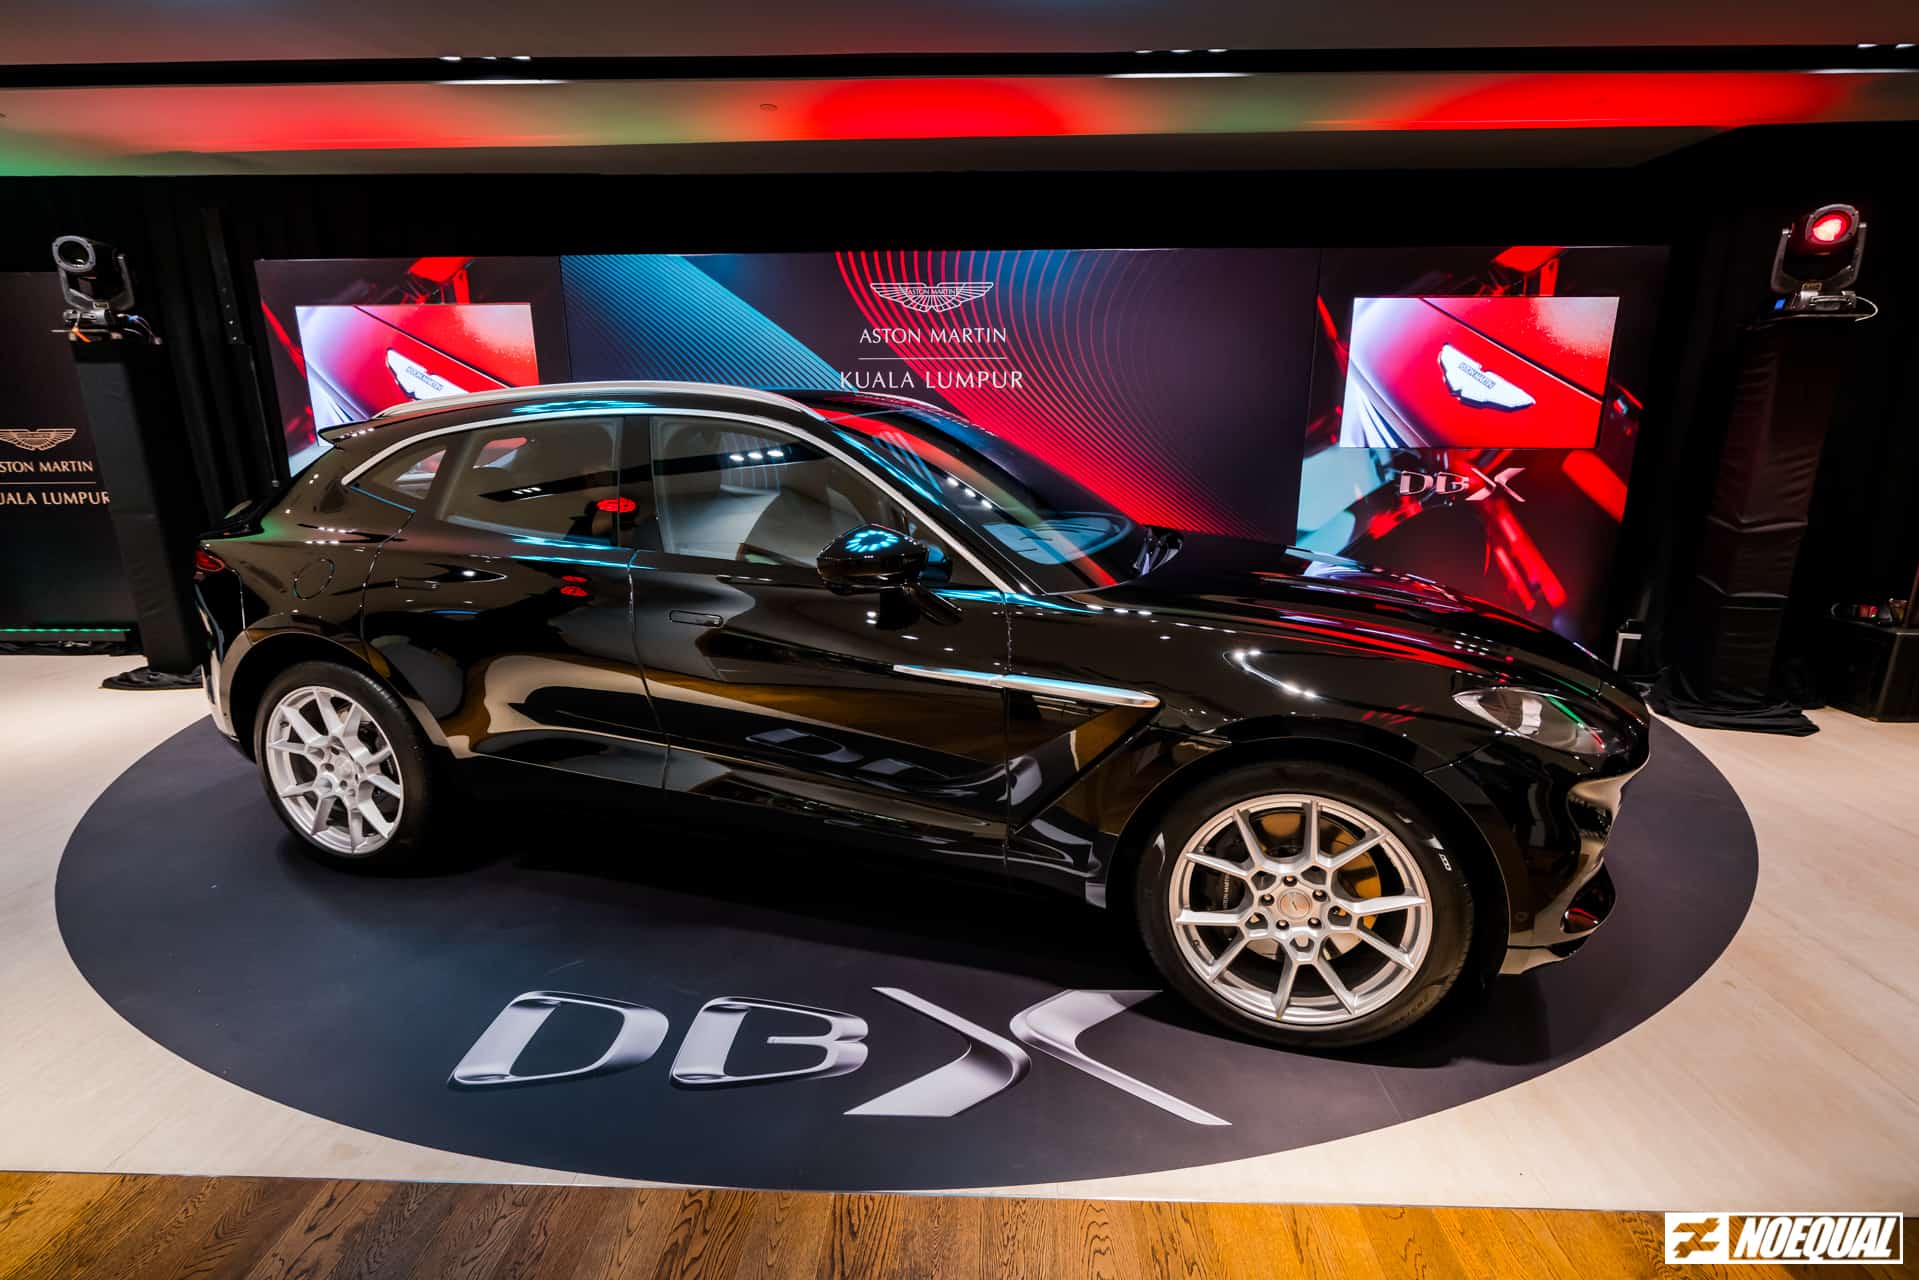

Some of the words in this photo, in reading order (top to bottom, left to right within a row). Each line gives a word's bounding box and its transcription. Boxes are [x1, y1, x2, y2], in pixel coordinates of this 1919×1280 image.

[859, 328, 920, 344] ASTON
[930, 327, 1007, 344] MARTIN
[840, 371, 915, 389] KUALA
[926, 371, 1023, 389] LUMPUR
[0, 460, 34, 473] STON
[39, 460, 94, 473] MARTIN
[1399, 467, 1526, 503] DBX
[41, 491, 111, 505] LUMPUR
[447, 986, 1233, 1126] DBX
